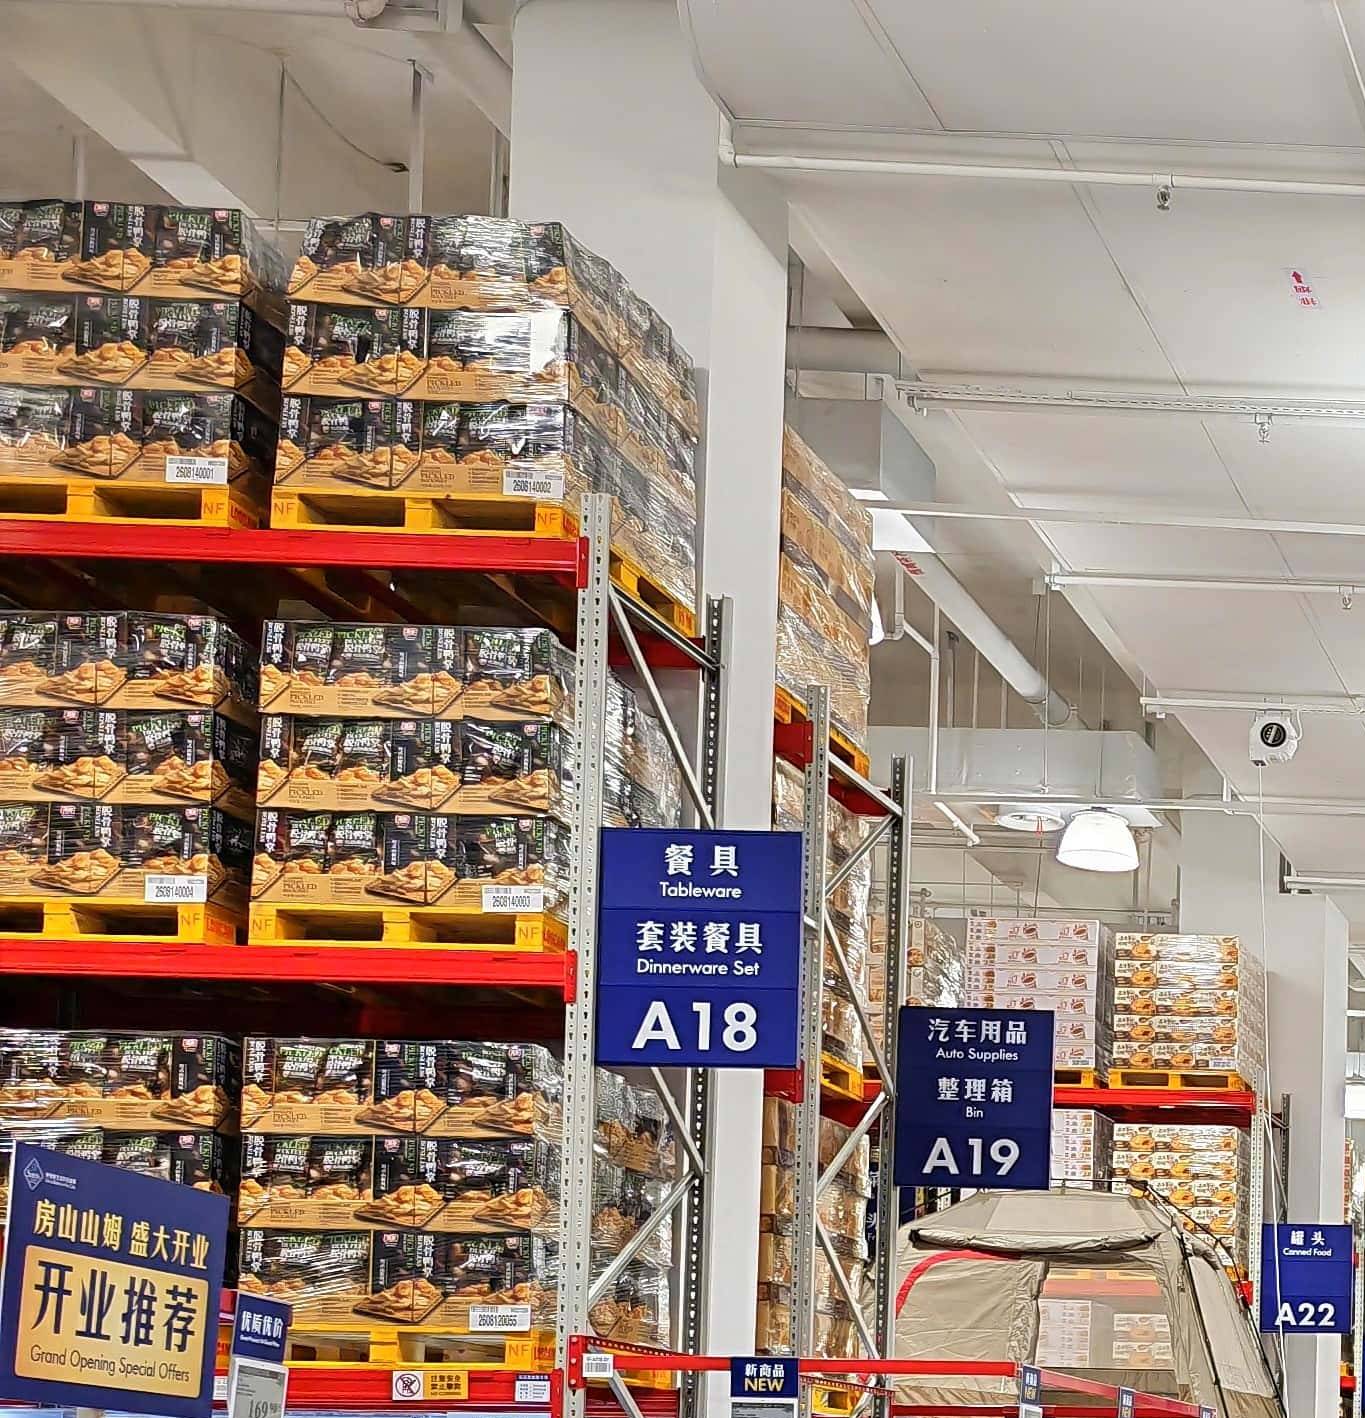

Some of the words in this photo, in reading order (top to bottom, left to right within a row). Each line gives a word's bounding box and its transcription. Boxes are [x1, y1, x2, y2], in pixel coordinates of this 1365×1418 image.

[203, 503, 224, 514] NF
[274, 503, 295, 514] NF
[664, 843, 739, 877] 餐具
[659, 881, 742, 899] Tableware
[182, 916, 201, 926] NF
[253, 920, 272, 931] NF
[519, 927, 538, 938] NF
[636, 920, 763, 954] 套装餐具
[637, 958, 729, 975] Dinnerware
[733, 961, 760, 976] Set
[631, 1001, 757, 1052] A18
[927, 1018, 1027, 1045] 汽车用品
[936, 1048, 965, 1060] Auto
[967, 1048, 1019, 1063] Supplies
[937, 1077, 1014, 1103] 整理箱
[966, 1106, 984, 1118] Bin
[922, 1137, 1020, 1176] A19
[34, 1199, 123, 1251] 房山山姆
[129, 1220, 209, 1270] 盛大开业
[1313, 1248, 1332, 1257] Food
[31, 1259, 199, 1353] 开业推荐
[1274, 1302, 1335, 1326] A22
[240, 1309, 284, 1340] 优质优价
[508, 1345, 529, 1356] NF
[30, 1344, 66, 1366] Grand
[70, 1351, 116, 1377] Opening
[119, 1357, 156, 1379] Special
[158, 1364, 190, 1383] Offers
[745, 1363, 785, 1378] 新商品
[744, 1378, 784, 1392] NEW
